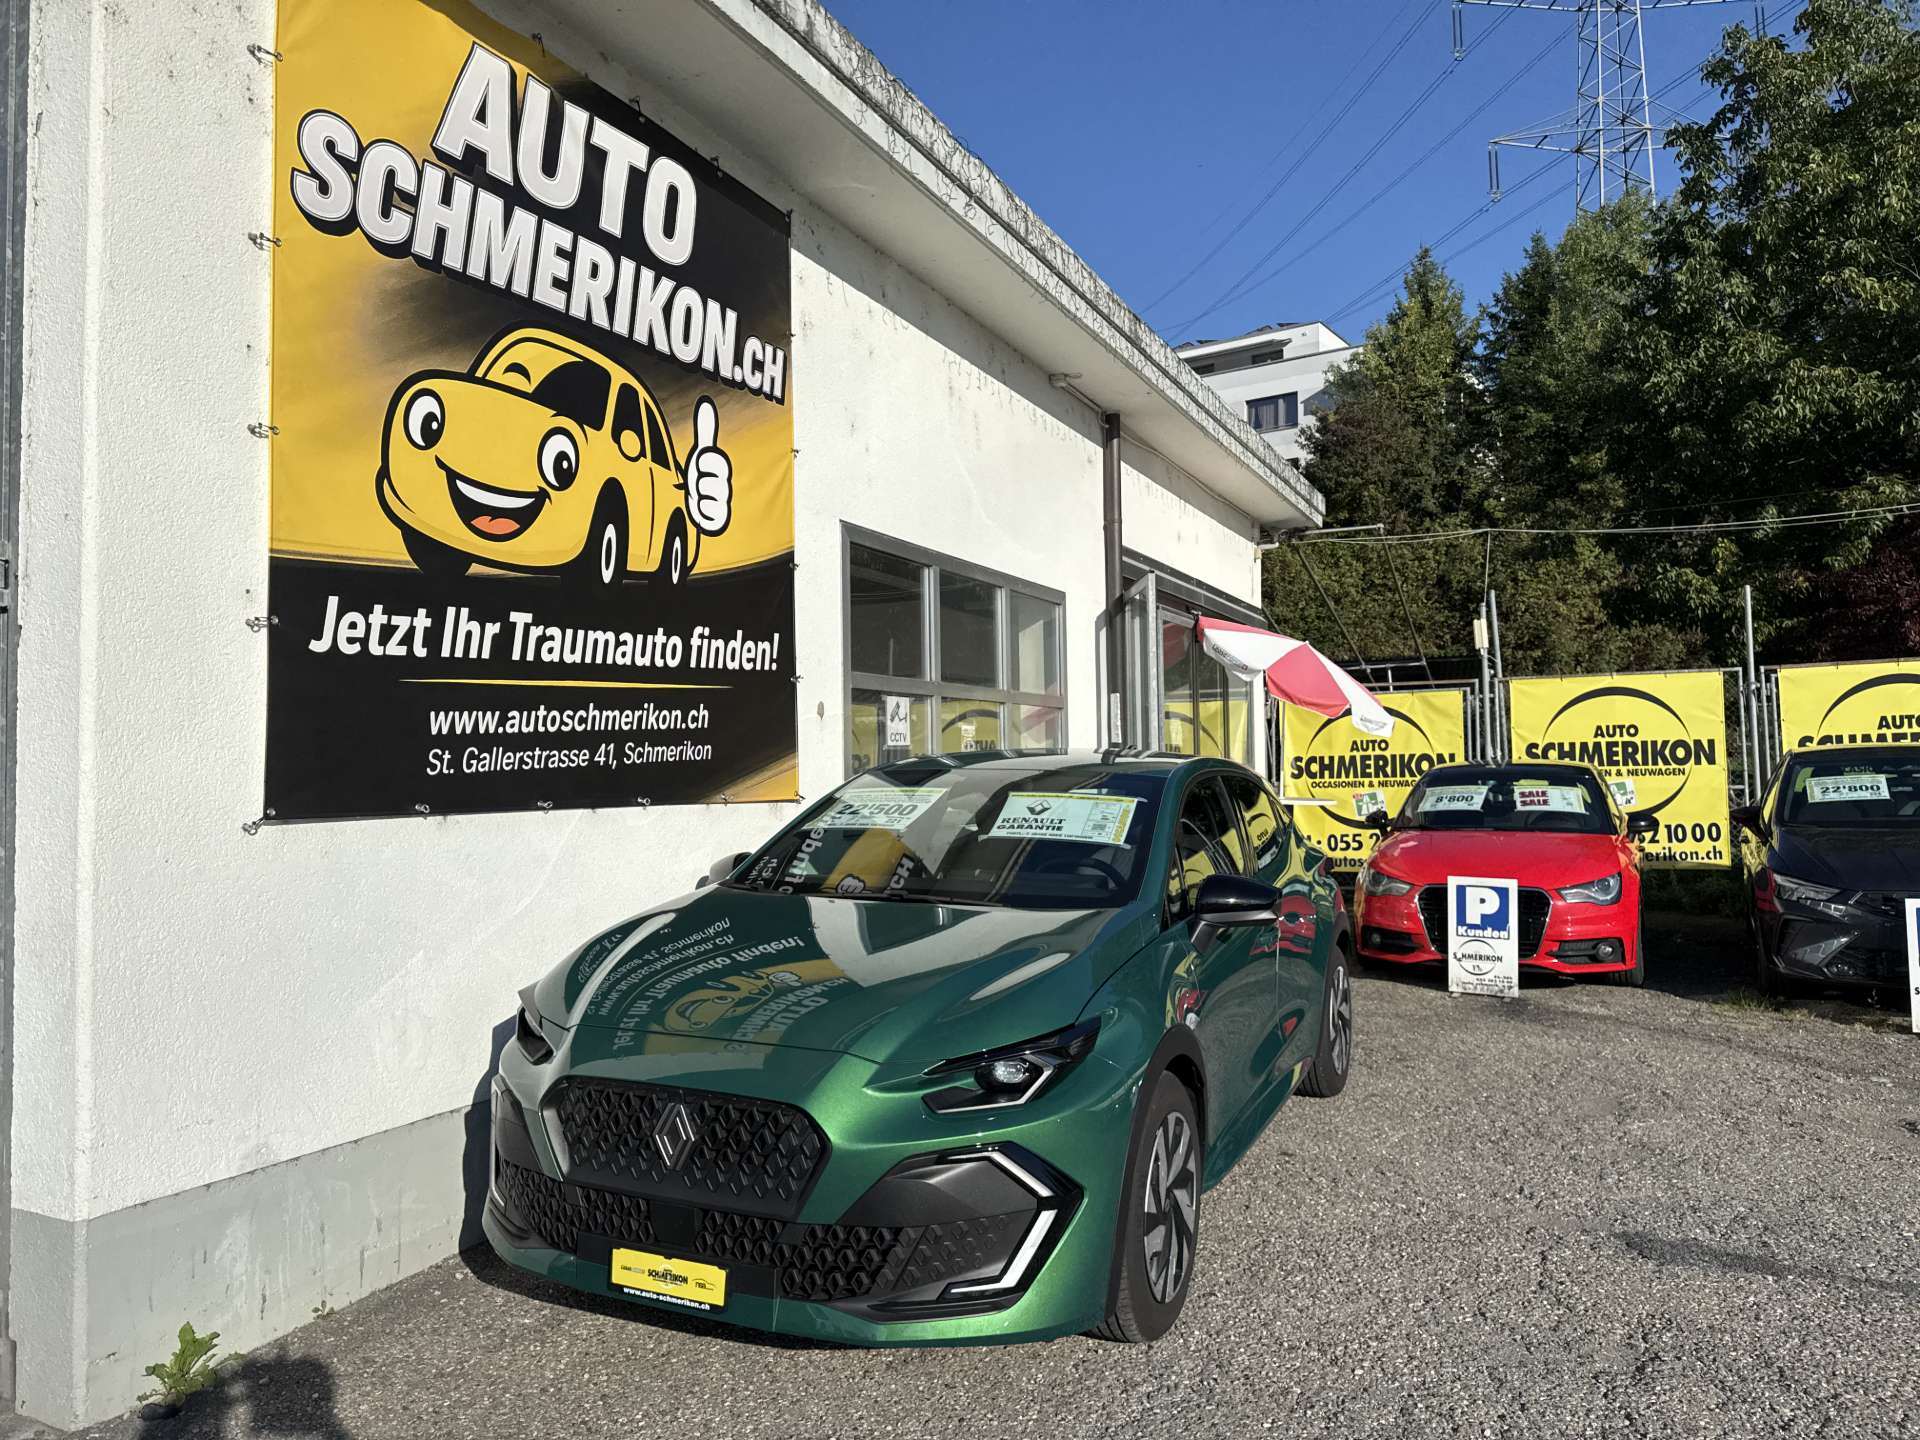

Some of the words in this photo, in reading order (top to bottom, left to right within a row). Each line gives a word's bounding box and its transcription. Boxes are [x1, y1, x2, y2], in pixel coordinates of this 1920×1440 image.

[434, 42, 697, 266] AUTO
[292, 111, 787, 400] SCHMERIKON.CH
[308, 595, 432, 656] Jetzt
[440, 606, 501, 660] Ihr
[509, 611, 683, 667] Traumauto
[689, 628, 779, 671] finden!
[428, 703, 710, 736] www.autoschmerikon.ch
[889, 732, 907, 743] CCTV
[1593, 724, 1639, 739] AUTO
[1350, 738, 1389, 752] AUTO
[1525, 738, 1716, 767] SCHMERIKON
[426, 748, 454, 776] St.
[462, 744, 589, 773] Gallerstrasse
[594, 743, 618, 770] 41,
[624, 741, 712, 766] Schmerikon
[1627, 767, 1686, 777] NEUWAGEN
[1311, 779, 1364, 789] OCCASIONEN
[1378, 779, 1416, 788] NEUWAG
[1820, 784, 1881, 794] 22'800
[1519, 790, 1548, 798] SALE
[996, 824, 1064, 832] GARANTIE
[1000, 816, 1066, 825] RENAULT
[1327, 833, 1363, 851] 055
[1643, 845, 1723, 862] erikon.ch
[1465, 886, 1500, 925] P
[1457, 925, 1508, 939] Kunden
[647, 1268, 689, 1285] SCHMERIKON
[623, 1287, 711, 1311] www.auto-schmerikon.ch
